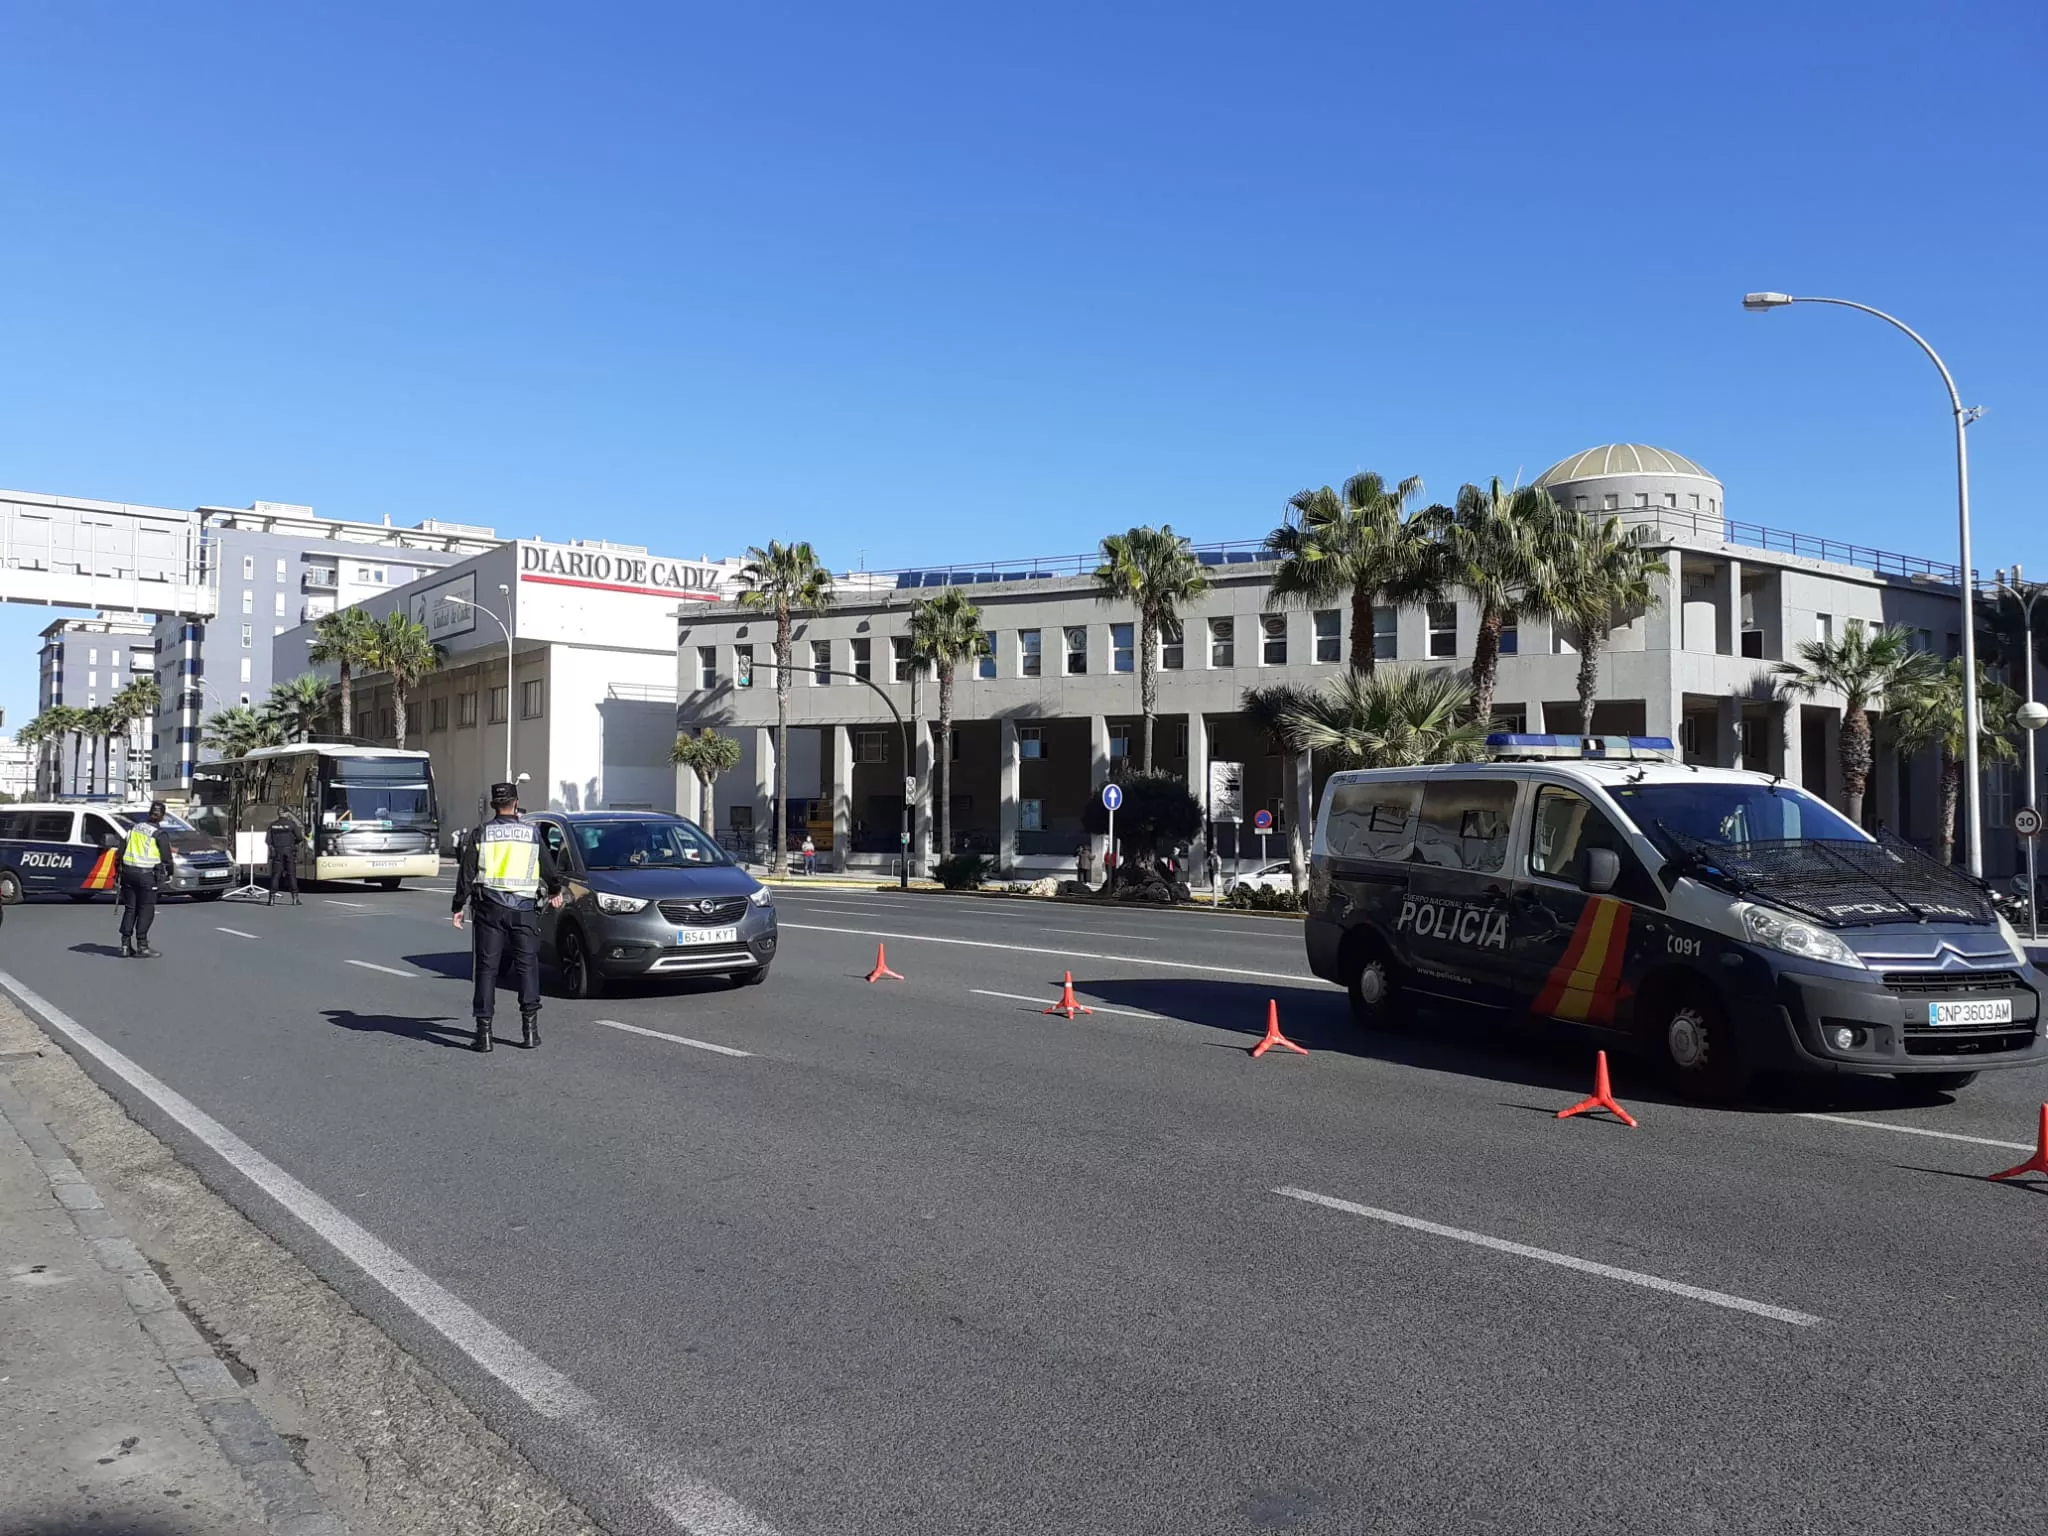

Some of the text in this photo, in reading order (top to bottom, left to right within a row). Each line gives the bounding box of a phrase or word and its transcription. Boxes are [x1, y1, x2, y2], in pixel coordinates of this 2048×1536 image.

[521, 545, 611, 580] DIARIO
[614, 557, 647, 583] DE
[2018, 817, 2034, 827] 30
[1402, 893, 1429, 903] CUERPO
[1429, 897, 1464, 909] NACIONAL
[684, 929, 735, 943] 6541 KYT
[1674, 936, 1701, 957] 091
